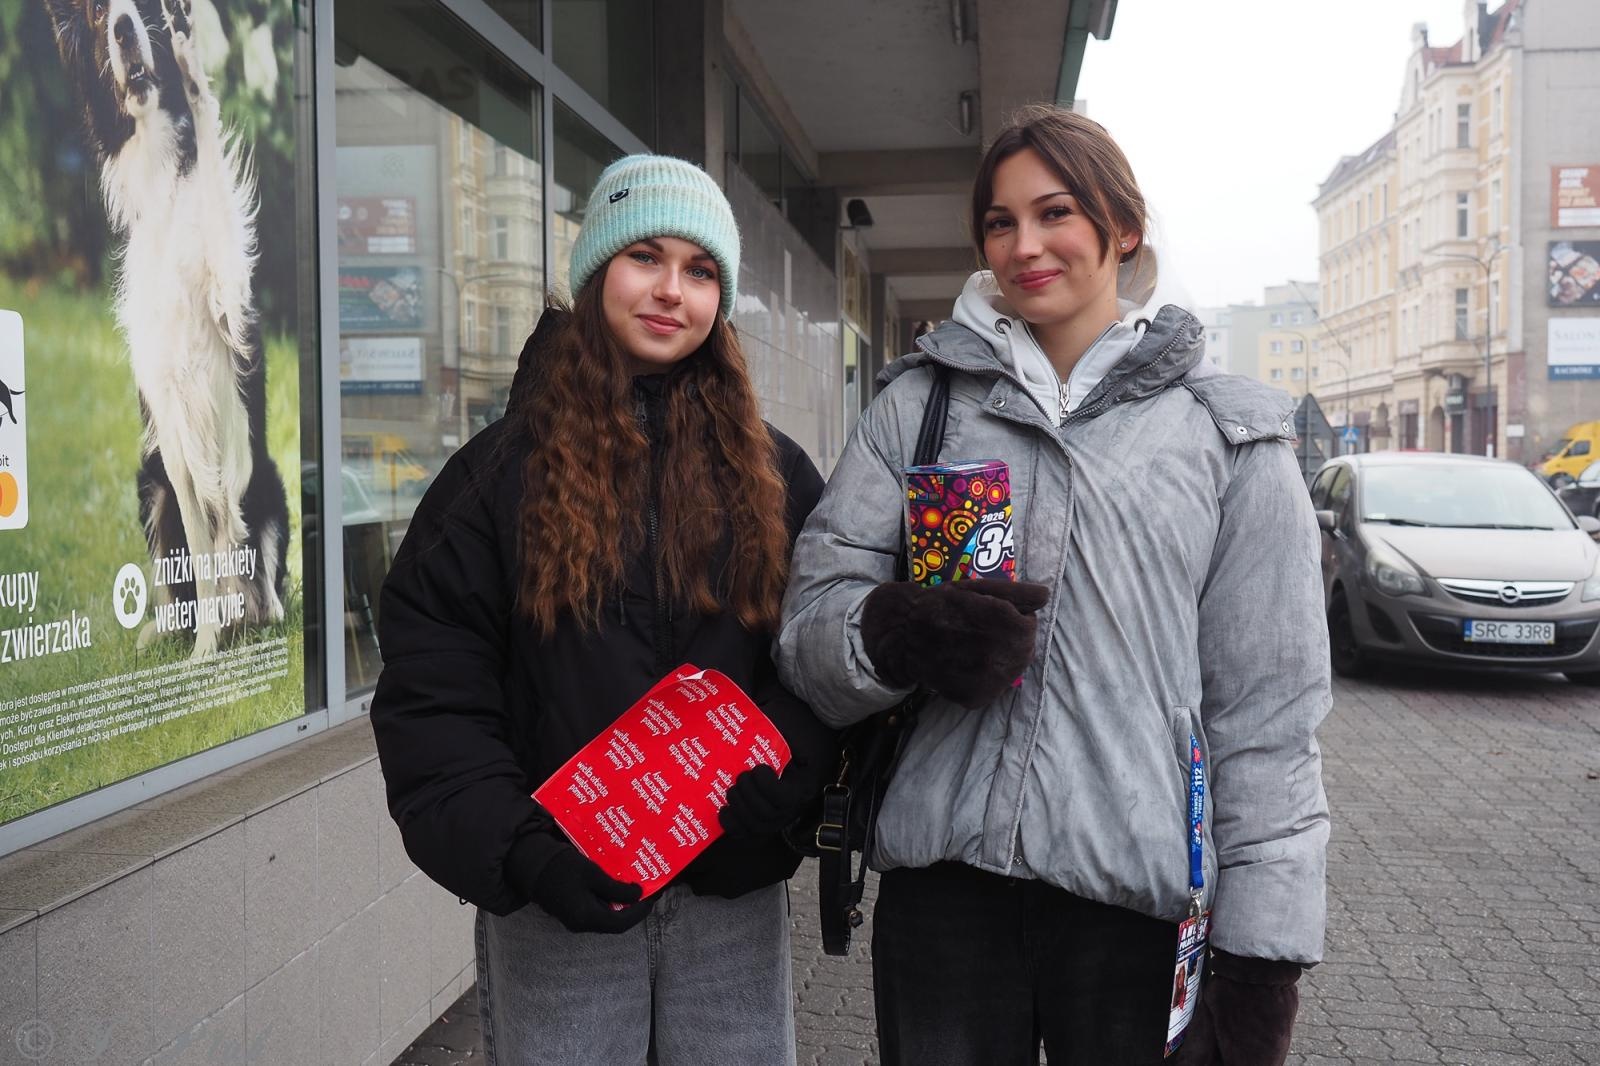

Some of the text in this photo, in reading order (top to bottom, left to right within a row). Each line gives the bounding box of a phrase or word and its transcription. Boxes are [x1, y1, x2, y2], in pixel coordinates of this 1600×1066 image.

[154, 543, 257, 586] zniżki na pakiety
[155, 587, 245, 634] weterynaryjne
[1, 609, 92, 663] zwierzaka
[1474, 622, 1552, 640] SRC 33R8
[18, 722, 37, 736] Karty
[38, 719, 54, 730] oraz
[2, 739, 33, 755] Dostępu
[12, 749, 42, 769] sposobu
[43, 738, 81, 758] korzystania
[1194, 767, 1203, 788] 112
